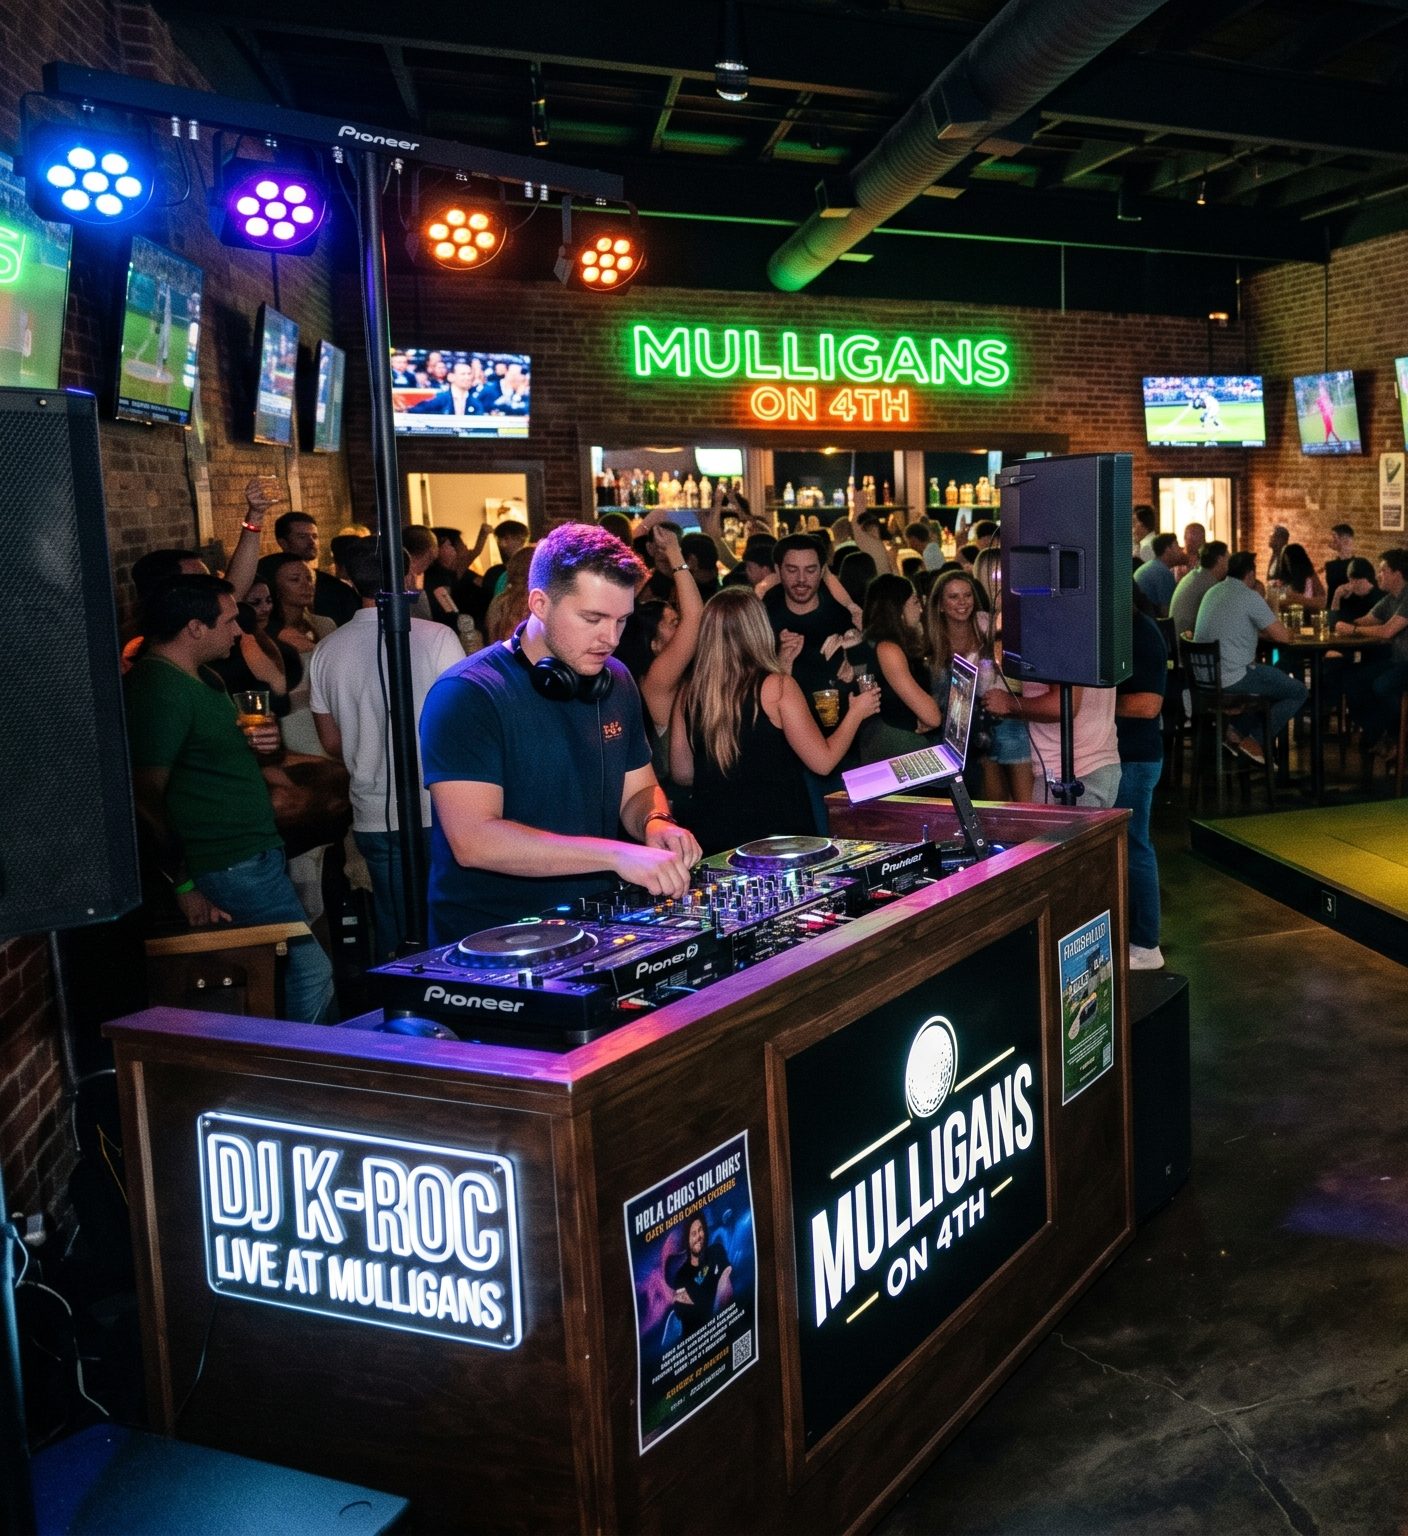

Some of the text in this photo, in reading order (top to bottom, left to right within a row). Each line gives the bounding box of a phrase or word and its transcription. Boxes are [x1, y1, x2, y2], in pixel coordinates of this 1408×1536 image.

[338, 125, 420, 151] Pioneer
[633, 325, 1010, 388] MULLIGANS
[750, 386, 910, 422] ON 4TH
[423, 985, 525, 1013] Pioneer
[207, 1132, 502, 1272] DJ K-ROC
[811, 1063, 1034, 1328] MULLIGANS
[887, 1187, 985, 1297] ON 4TH
[215, 1234, 503, 1330] LIVE AT MULLIGANS
